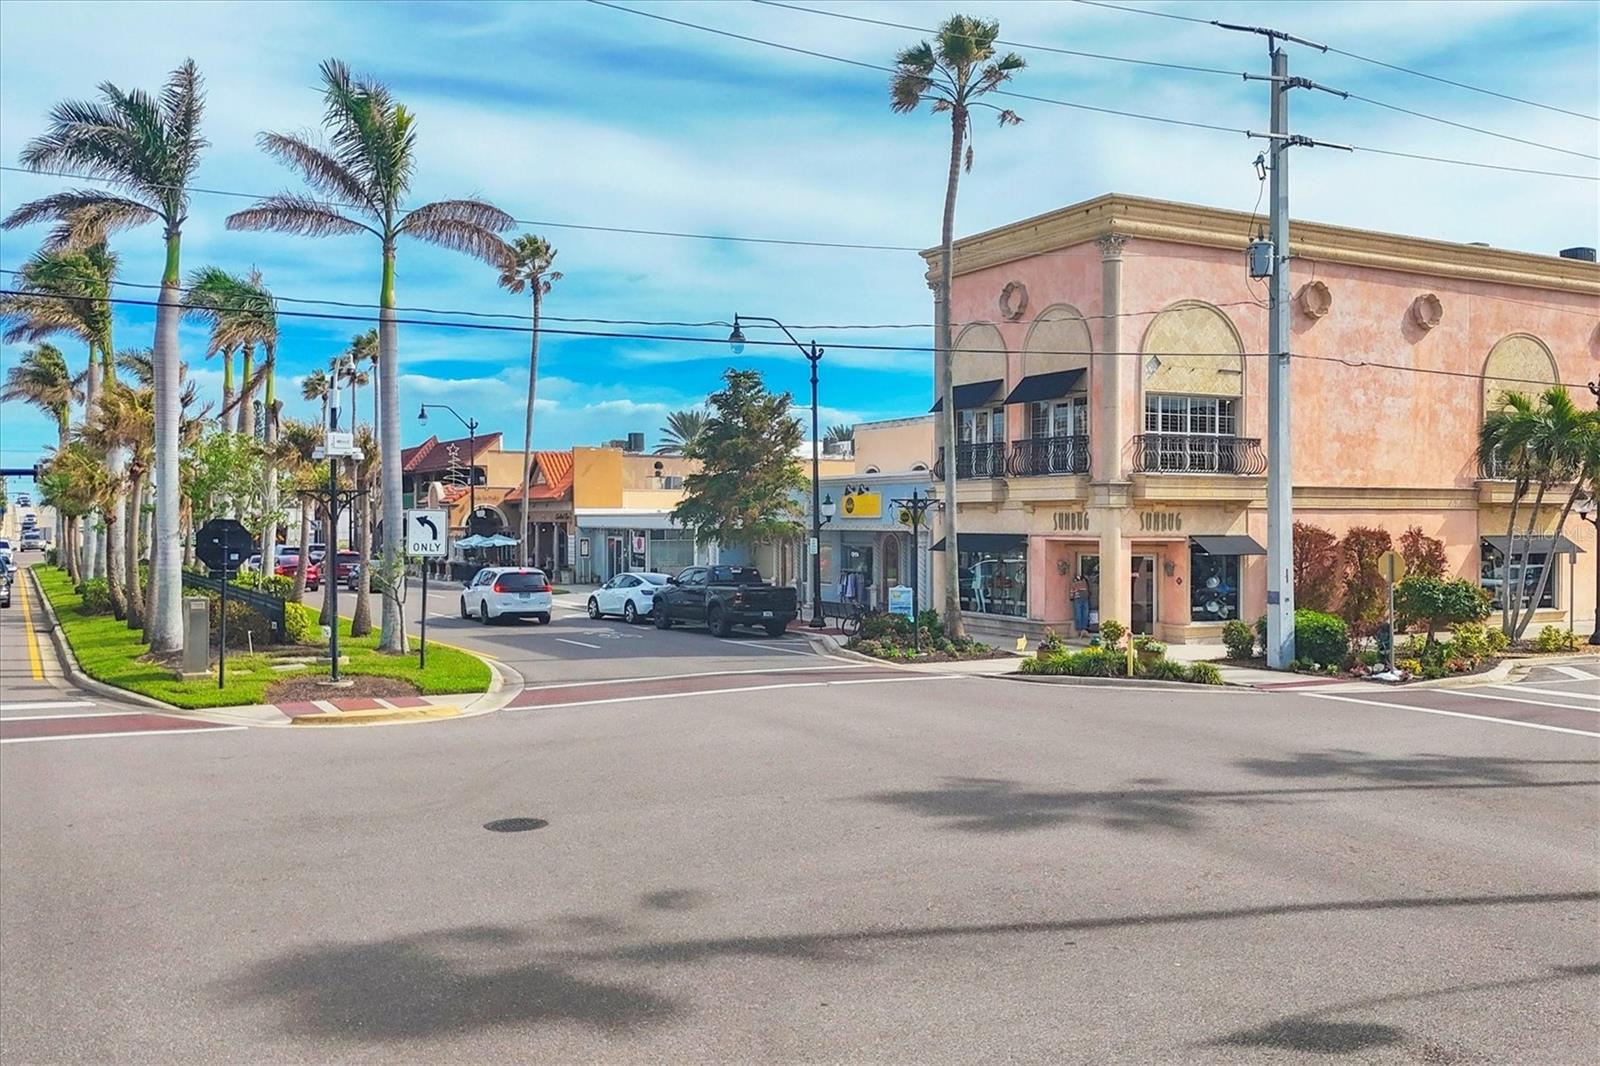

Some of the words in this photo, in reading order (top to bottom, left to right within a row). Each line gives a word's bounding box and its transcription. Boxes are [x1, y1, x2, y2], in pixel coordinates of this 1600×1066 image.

[1053, 511, 1089, 531] SUNBUG
[1139, 511, 1182, 532] SUNBUG
[413, 543, 441, 552] ONLY
